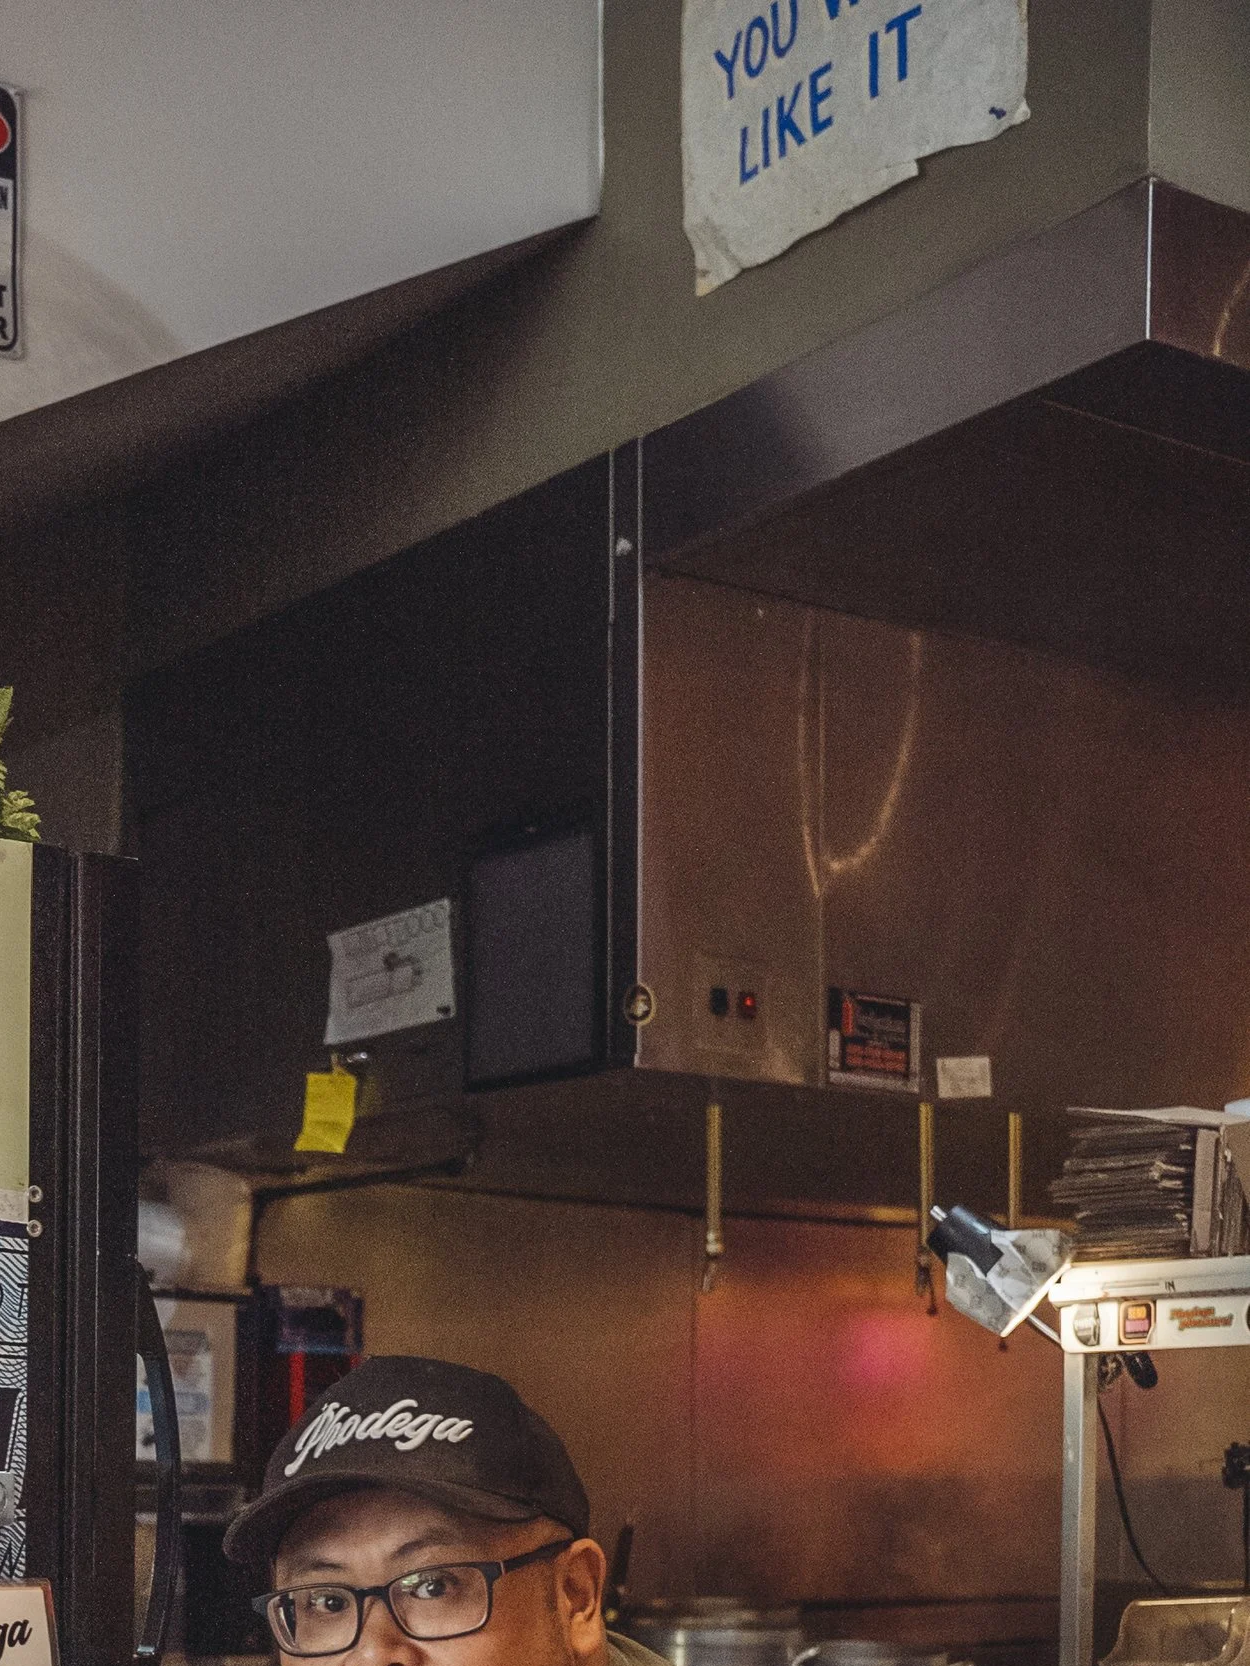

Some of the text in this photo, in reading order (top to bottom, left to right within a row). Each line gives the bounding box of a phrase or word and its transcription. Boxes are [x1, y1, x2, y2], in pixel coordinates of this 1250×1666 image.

[714, 0, 799, 100] YOU
[740, 3, 922, 186] LIKE IT
[284, 1399, 474, 1477] Phodega
